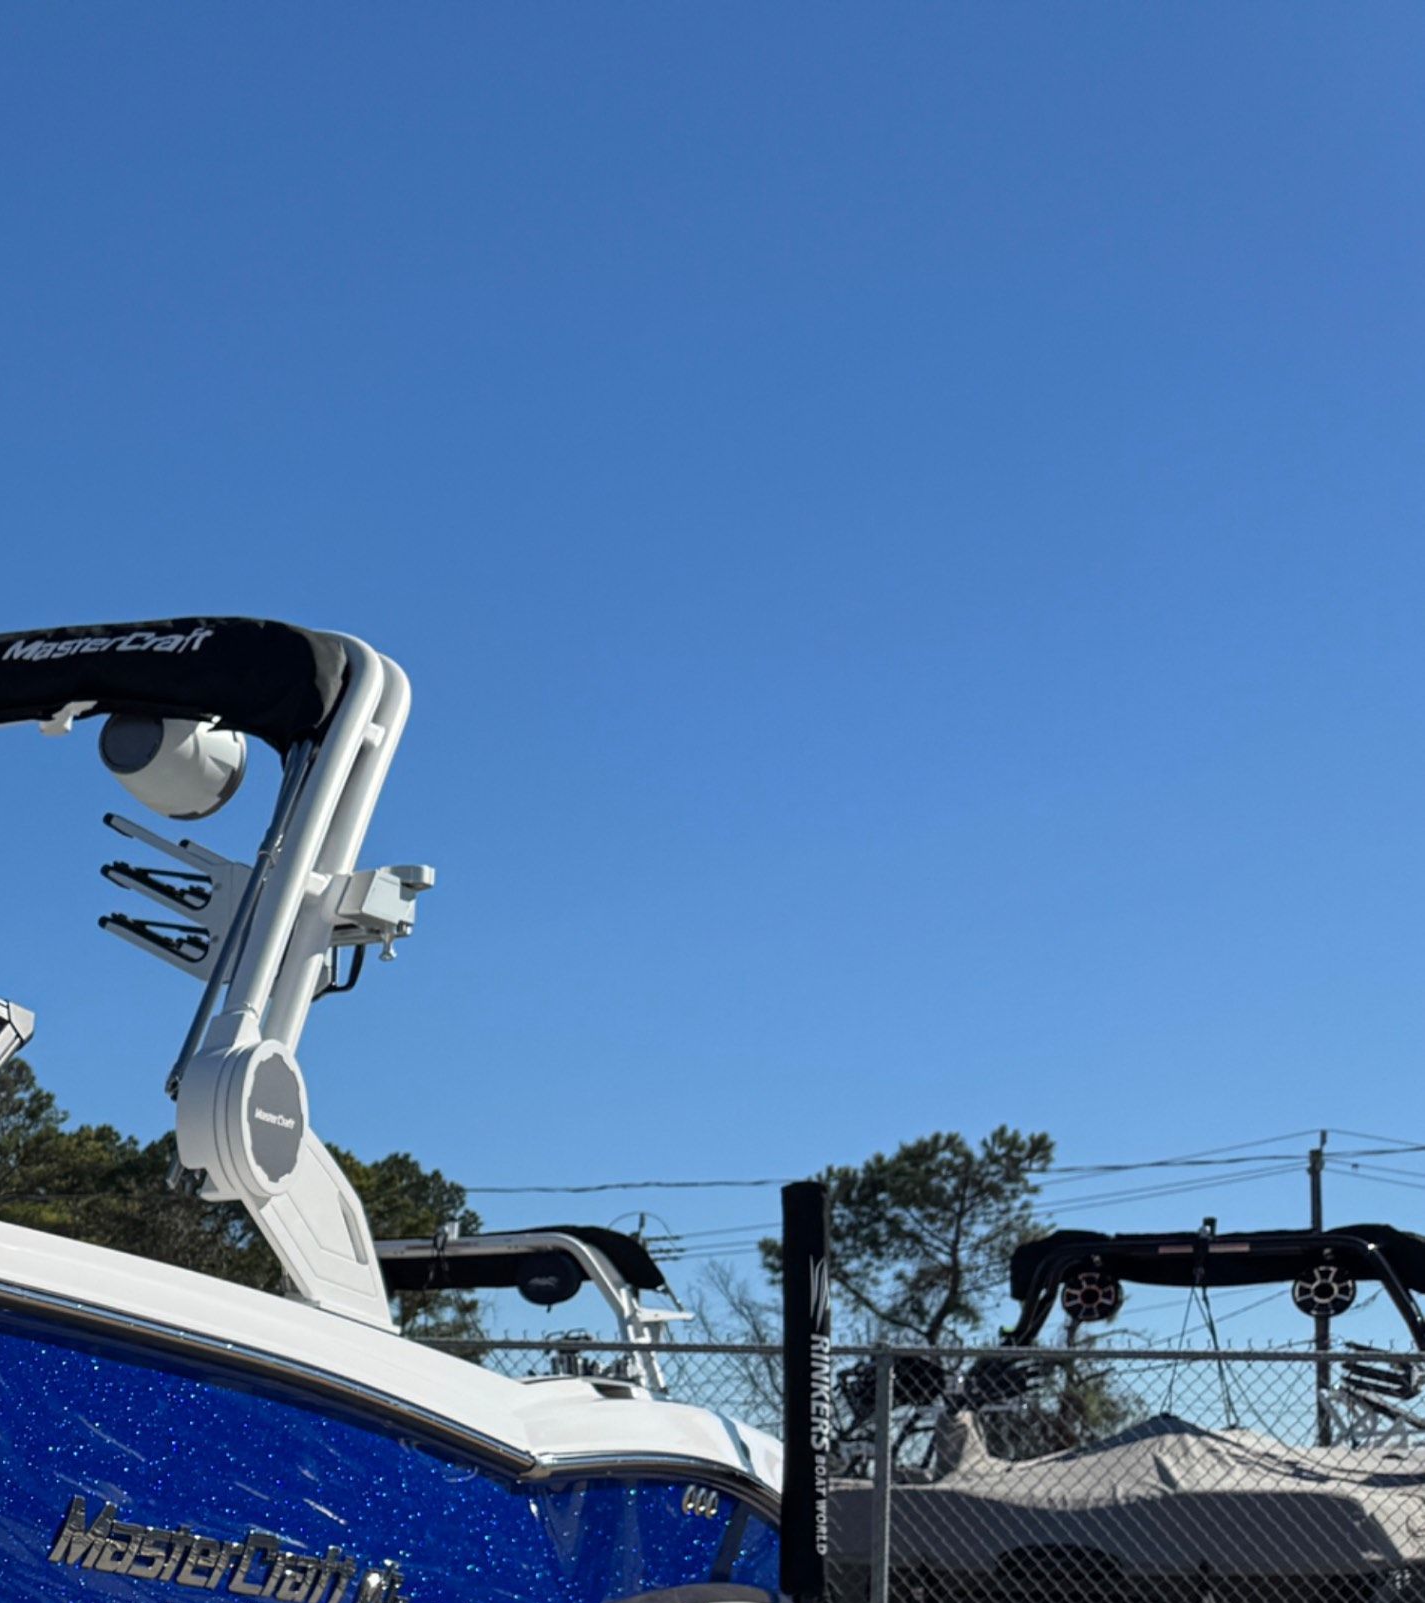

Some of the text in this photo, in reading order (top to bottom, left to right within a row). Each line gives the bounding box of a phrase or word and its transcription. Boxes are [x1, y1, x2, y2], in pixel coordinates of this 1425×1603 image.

[1, 627, 215, 662] MasterCraft
[810, 1333, 831, 1556] RINKERS BOAT WORLD
